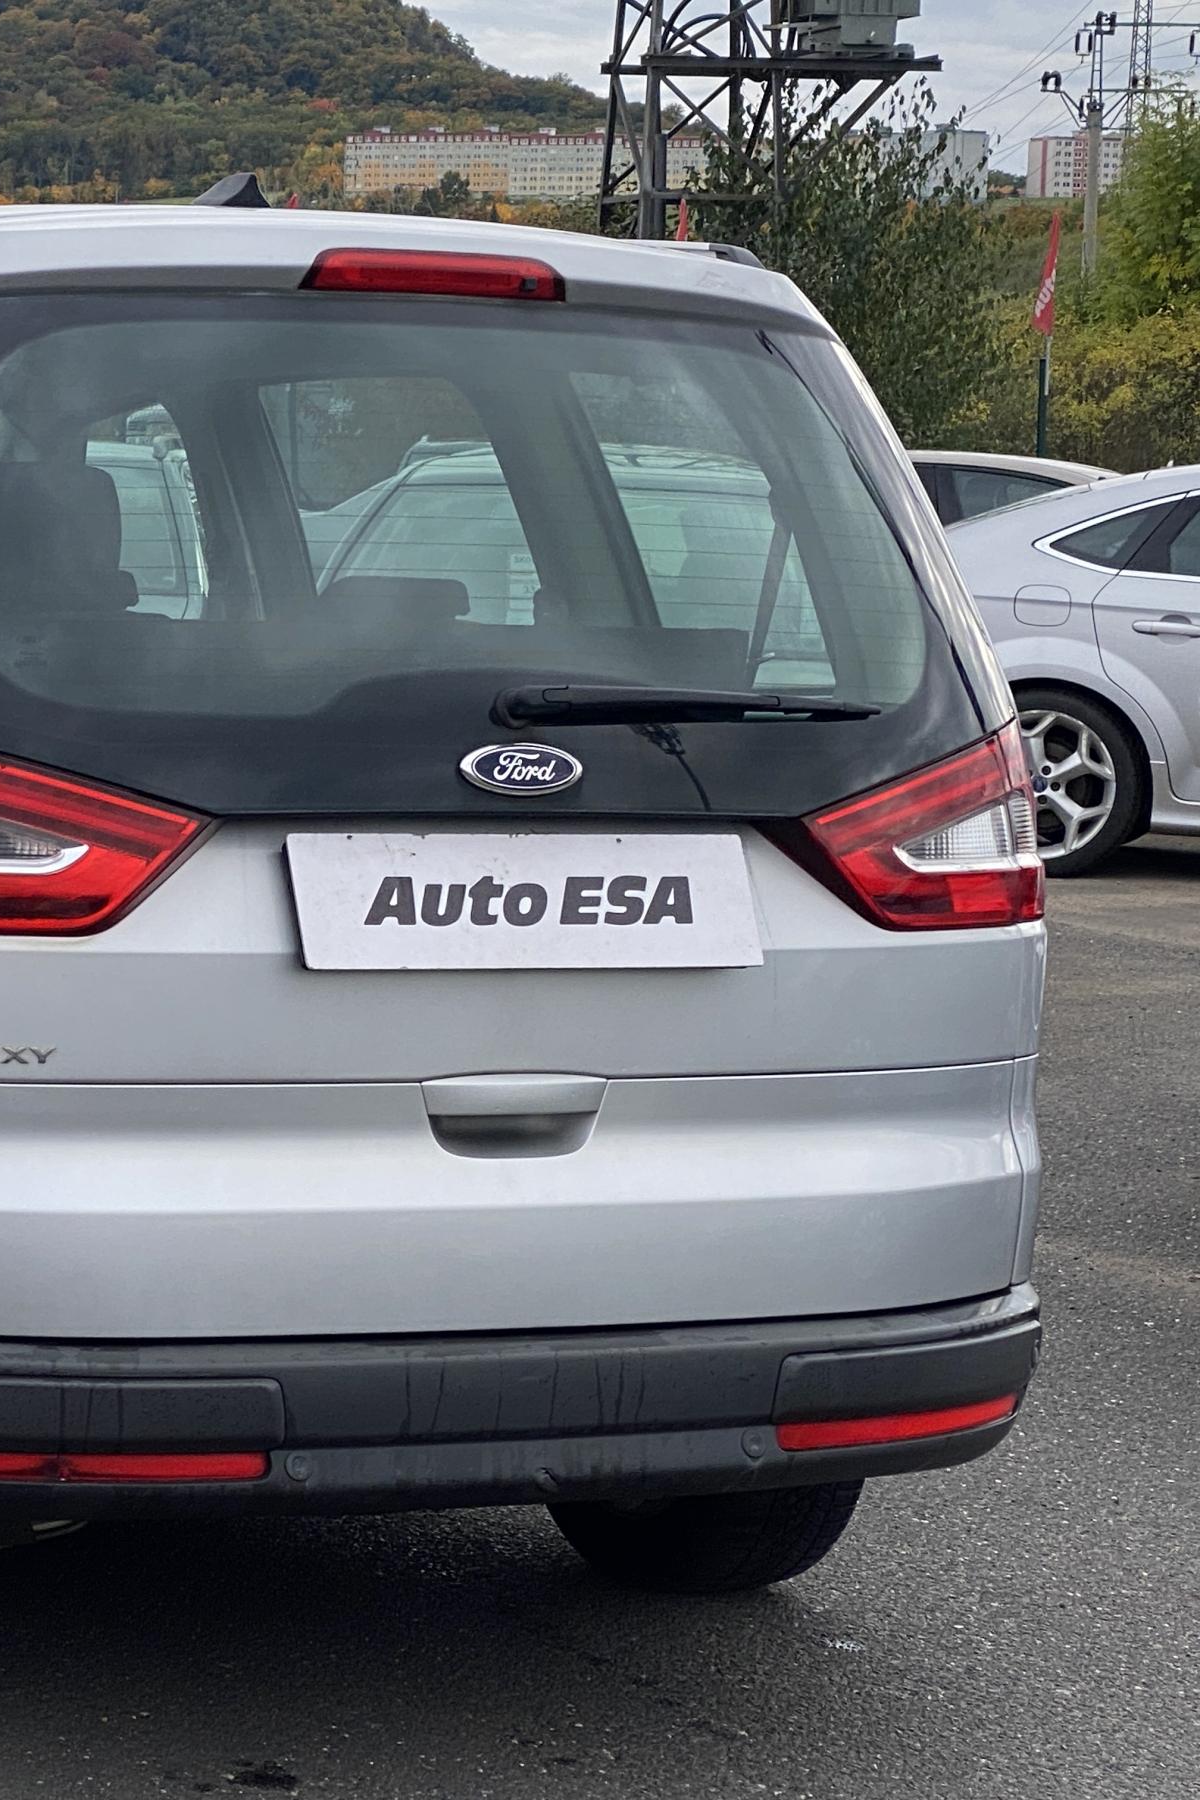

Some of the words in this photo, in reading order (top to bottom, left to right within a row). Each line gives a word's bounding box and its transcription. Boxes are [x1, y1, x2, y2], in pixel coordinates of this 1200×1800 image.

[493, 751, 556, 782] Ford
[364, 875, 548, 927] Auto
[559, 874, 694, 925] ESA
